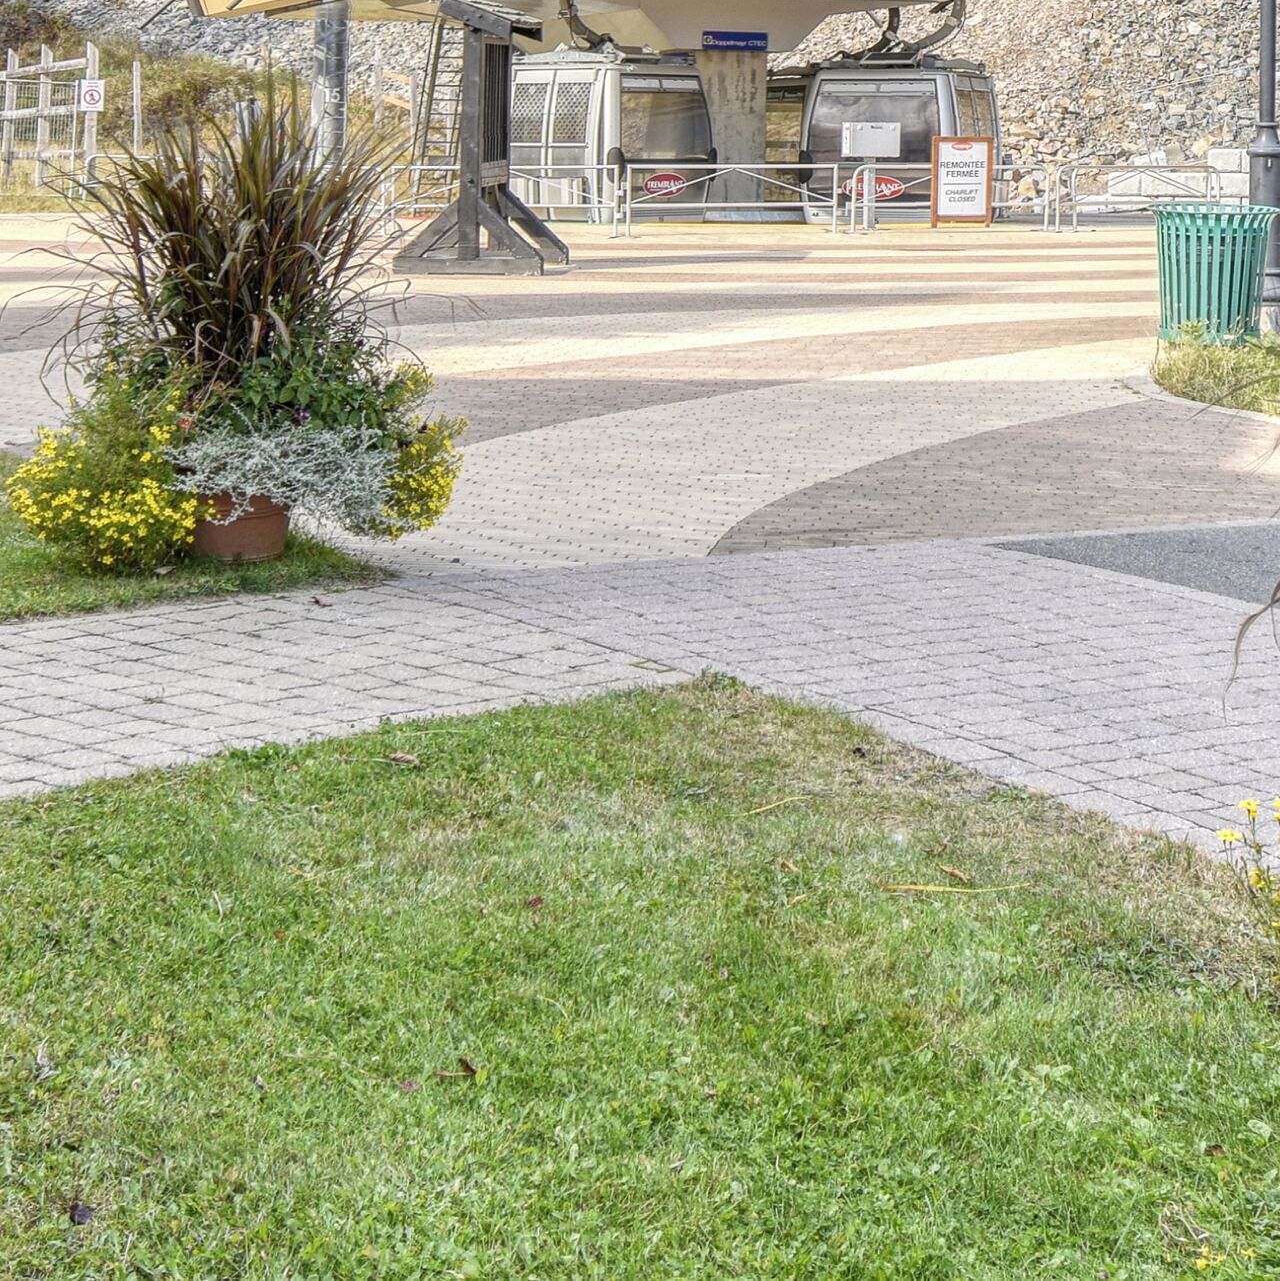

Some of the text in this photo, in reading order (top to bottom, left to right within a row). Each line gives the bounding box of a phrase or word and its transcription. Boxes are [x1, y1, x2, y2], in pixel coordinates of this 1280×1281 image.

[324, 88, 341, 102] 15
[940, 160, 985, 169] REMONTÉE
[946, 170, 980, 178] FERMÉE
